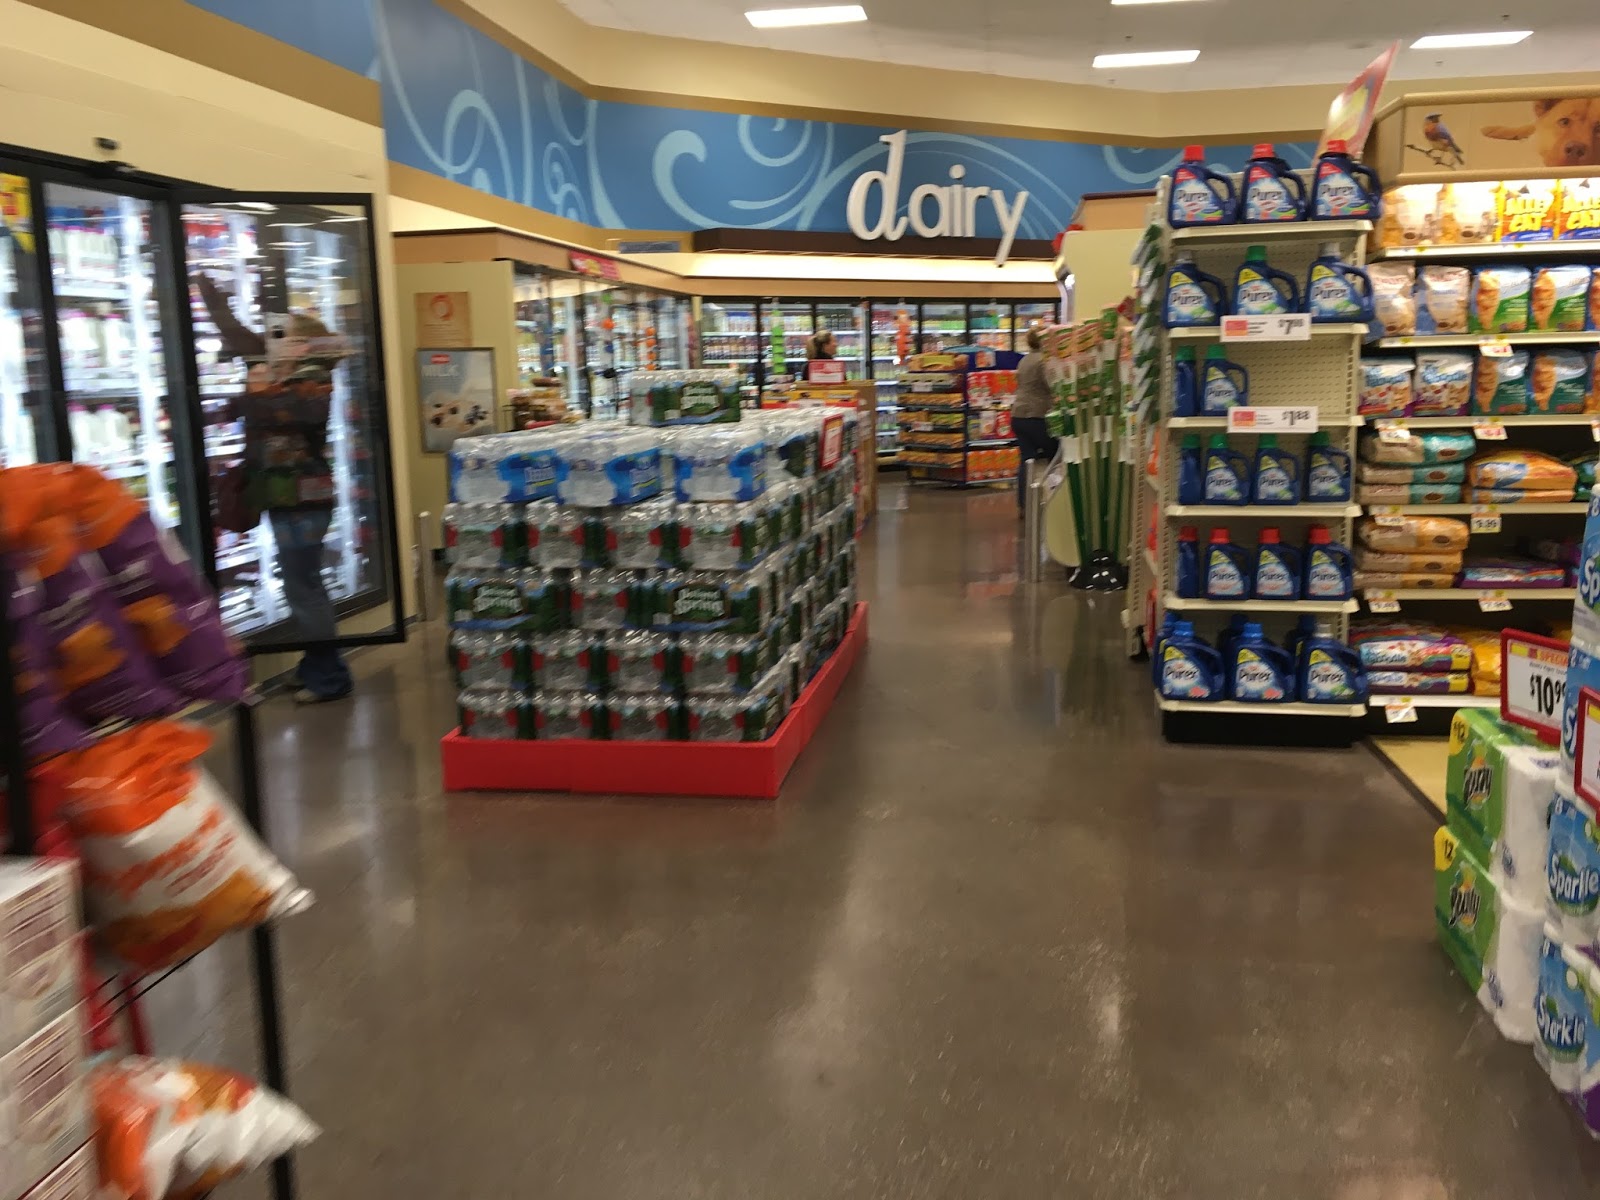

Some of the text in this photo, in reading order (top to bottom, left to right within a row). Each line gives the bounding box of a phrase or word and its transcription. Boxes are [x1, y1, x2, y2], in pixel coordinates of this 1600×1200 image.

[1177, 189, 1208, 204] Purex
[1250, 186, 1283, 202] Purex
[1320, 183, 1354, 198] Purex
[846, 129, 1029, 268] dairy
[1509, 213, 1547, 232] CAT
[1171, 292, 1202, 306] Purex
[1241, 288, 1273, 304] Purex
[1313, 287, 1347, 302] Purex
[1206, 386, 1235, 398] Purex
[1206, 476, 1236, 489] Purex
[1259, 476, 1289, 489] Purex
[1311, 473, 1341, 486] Purex
[1210, 568, 1237, 582] Purex
[1259, 568, 1286, 582] Purex
[1311, 568, 1340, 582] Purex
[1165, 665, 1200, 682] Purex
[1238, 666, 1272, 683] Purex
[1311, 665, 1345, 683] Purex
[1550, 852, 1600, 899] Sparkle
[1537, 994, 1585, 1047] Sparkle
